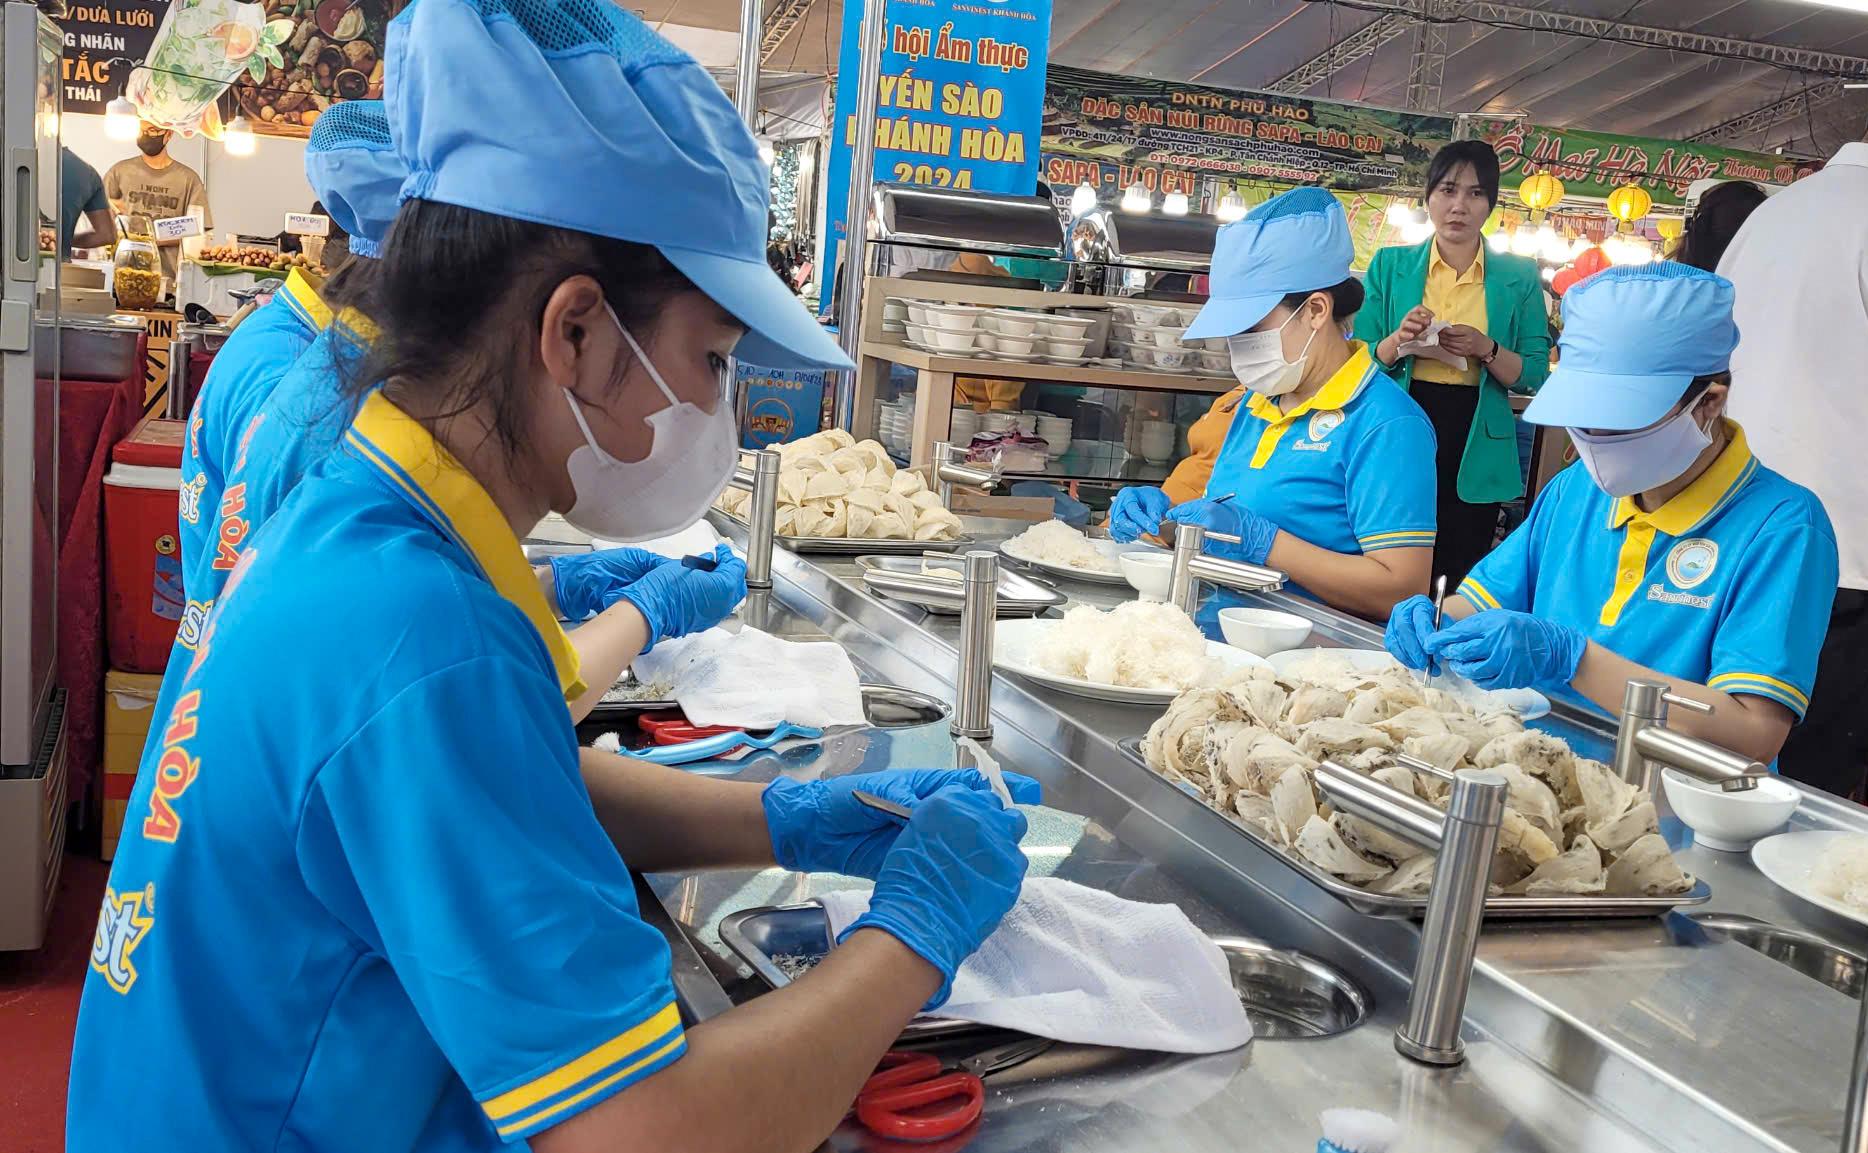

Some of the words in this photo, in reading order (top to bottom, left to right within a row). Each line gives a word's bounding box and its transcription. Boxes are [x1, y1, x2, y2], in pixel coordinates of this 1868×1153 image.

[115, 9, 154, 27] LƯỚI
[80, 33, 125, 51] NHÃN
[893, 24, 932, 61] hội
[934, 21, 972, 63] Ẩm
[977, 38, 1029, 73] thực
[62, 51, 110, 84] TẮC
[64, 85, 101, 102] THÁI
[879, 67, 933, 111] YẾN
[941, 81, 1003, 119] SÀO
[1172, 92, 1222, 110] DNTN
[1081, 97, 1121, 121] ĐẶC
[1125, 102, 1162, 125] SẢN
[1167, 108, 1199, 129] NÚI
[1204, 114, 1253, 136] RỪNG
[1256, 122, 1301, 143] SAPA
[1316, 129, 1350, 150] LÀO
[1354, 135, 1384, 153] CAI
[960, 126, 1025, 163] HÒA
[1093, 132, 1137, 146] 411/24/17
[1171, 142, 1199, 153] TCH21
[1376, 167, 1398, 178] Minh
[1150, 128, 1320, 157] www.nongsansachphuhao.com
[1048, 157, 1100, 188] SAPA
[1170, 154, 1198, 167] 0972
[1199, 159, 1226, 170] 6666
[1228, 162, 1241, 172] 38
[1249, 165, 1276, 177] 0907
[1277, 168, 1302, 180] 5555
[1303, 171, 1318, 182] 92
[1595, 143, 1649, 187] Hà
[143, 690, 201, 843] HÒA
